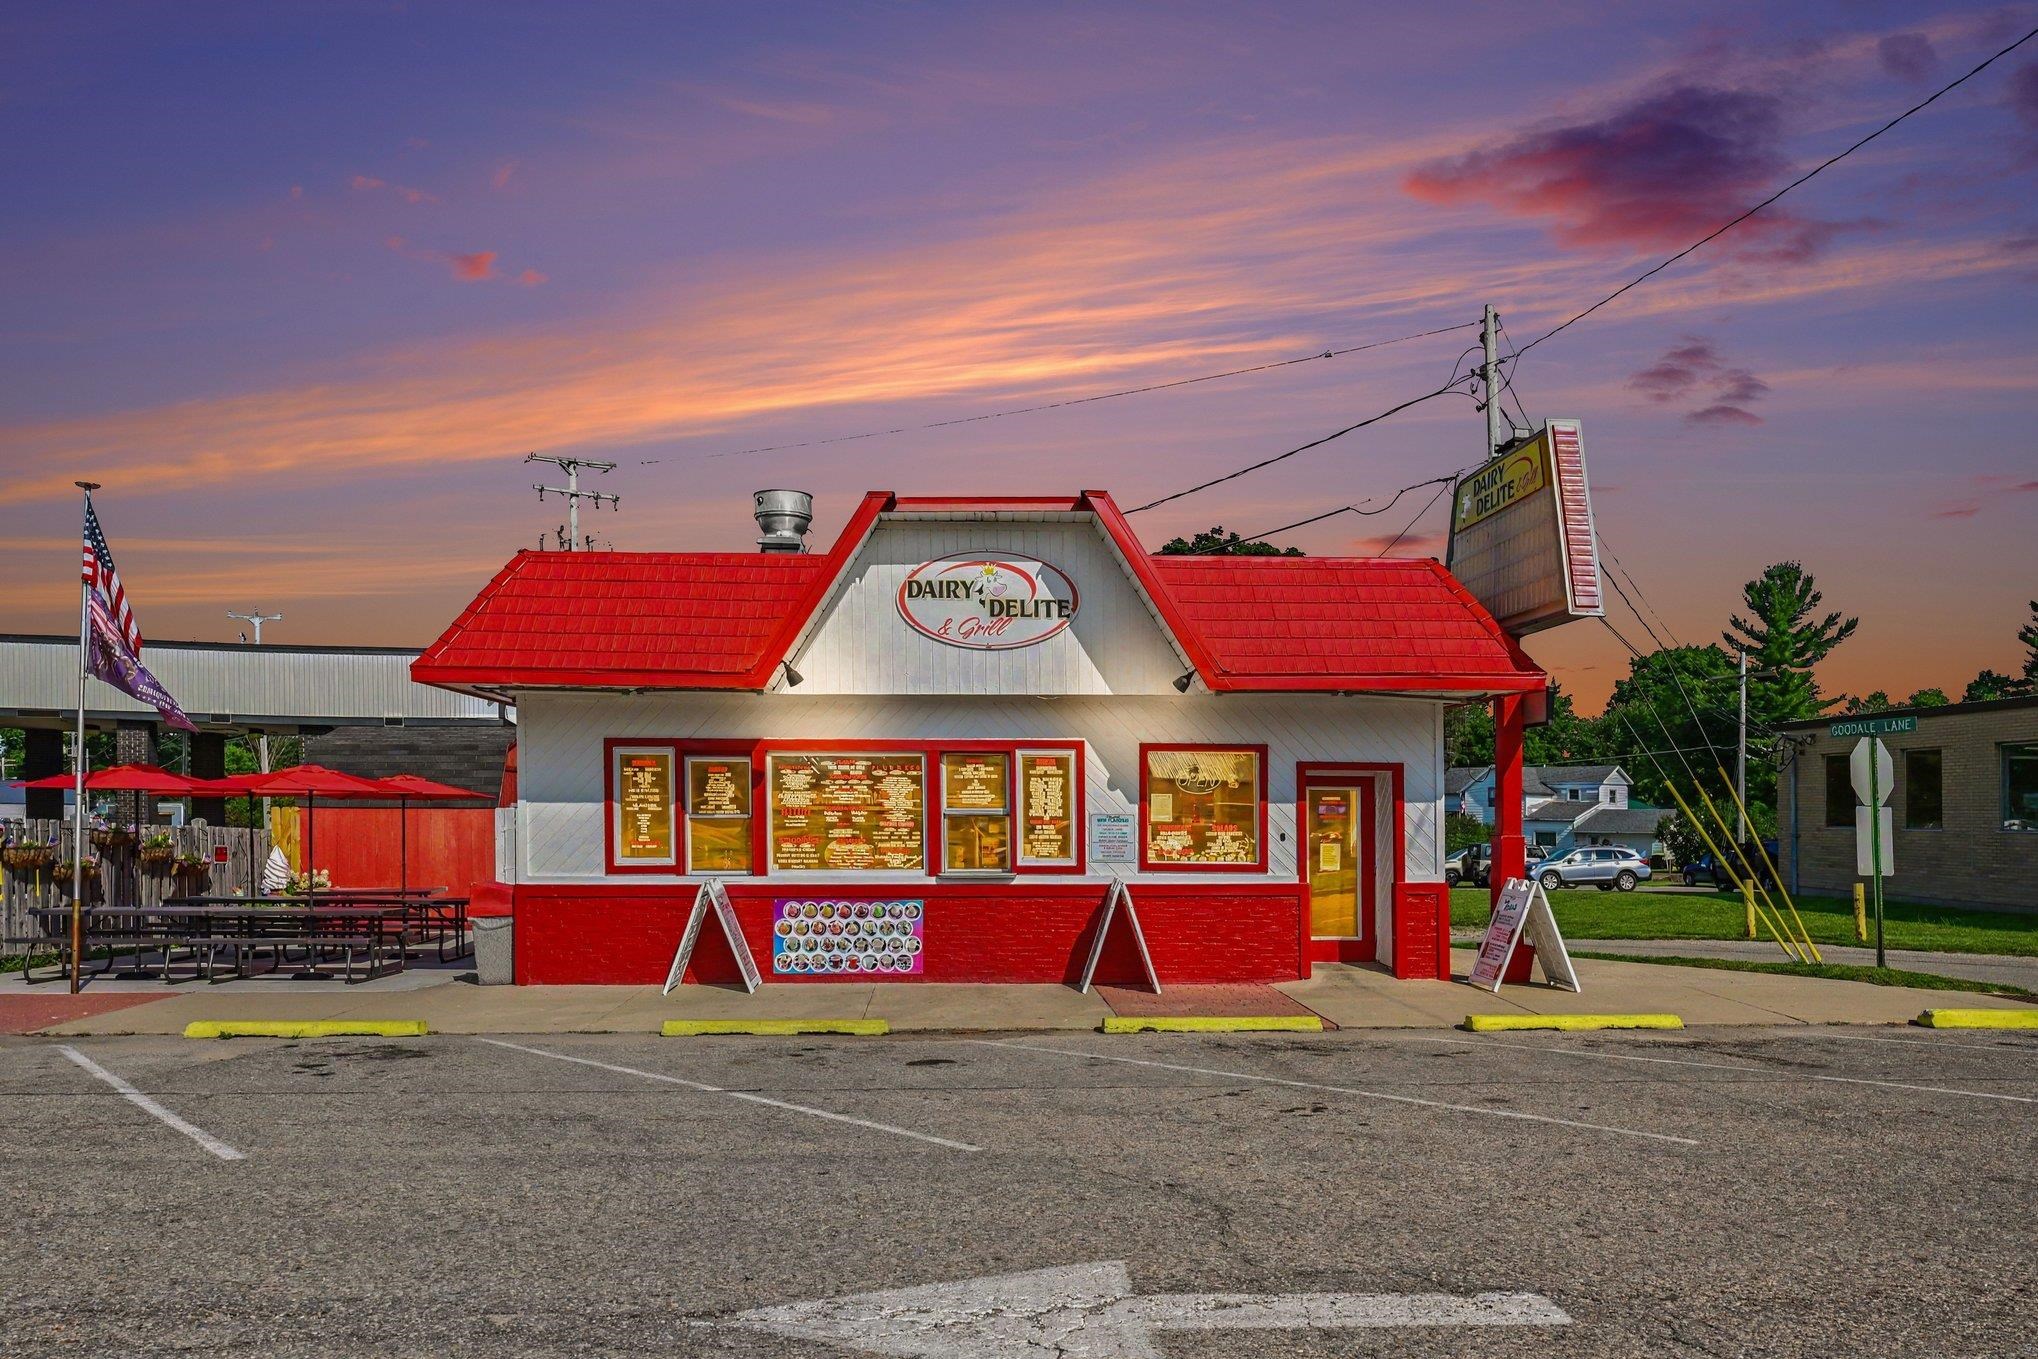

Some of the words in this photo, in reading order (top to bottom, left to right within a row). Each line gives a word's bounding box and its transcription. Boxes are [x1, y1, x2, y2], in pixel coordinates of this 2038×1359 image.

[1473, 463, 1505, 497] DAIRY
[1476, 480, 1515, 516] DELITE
[907, 579, 976, 599] DAIRY
[989, 599, 1071, 618] DELITE
[937, 617, 953, 636] &
[957, 616, 1014, 640] Grill
[1831, 722, 1876, 736] GOODALE
[1884, 719, 1911, 732] LANE
[1179, 773, 1217, 788] OPEN
